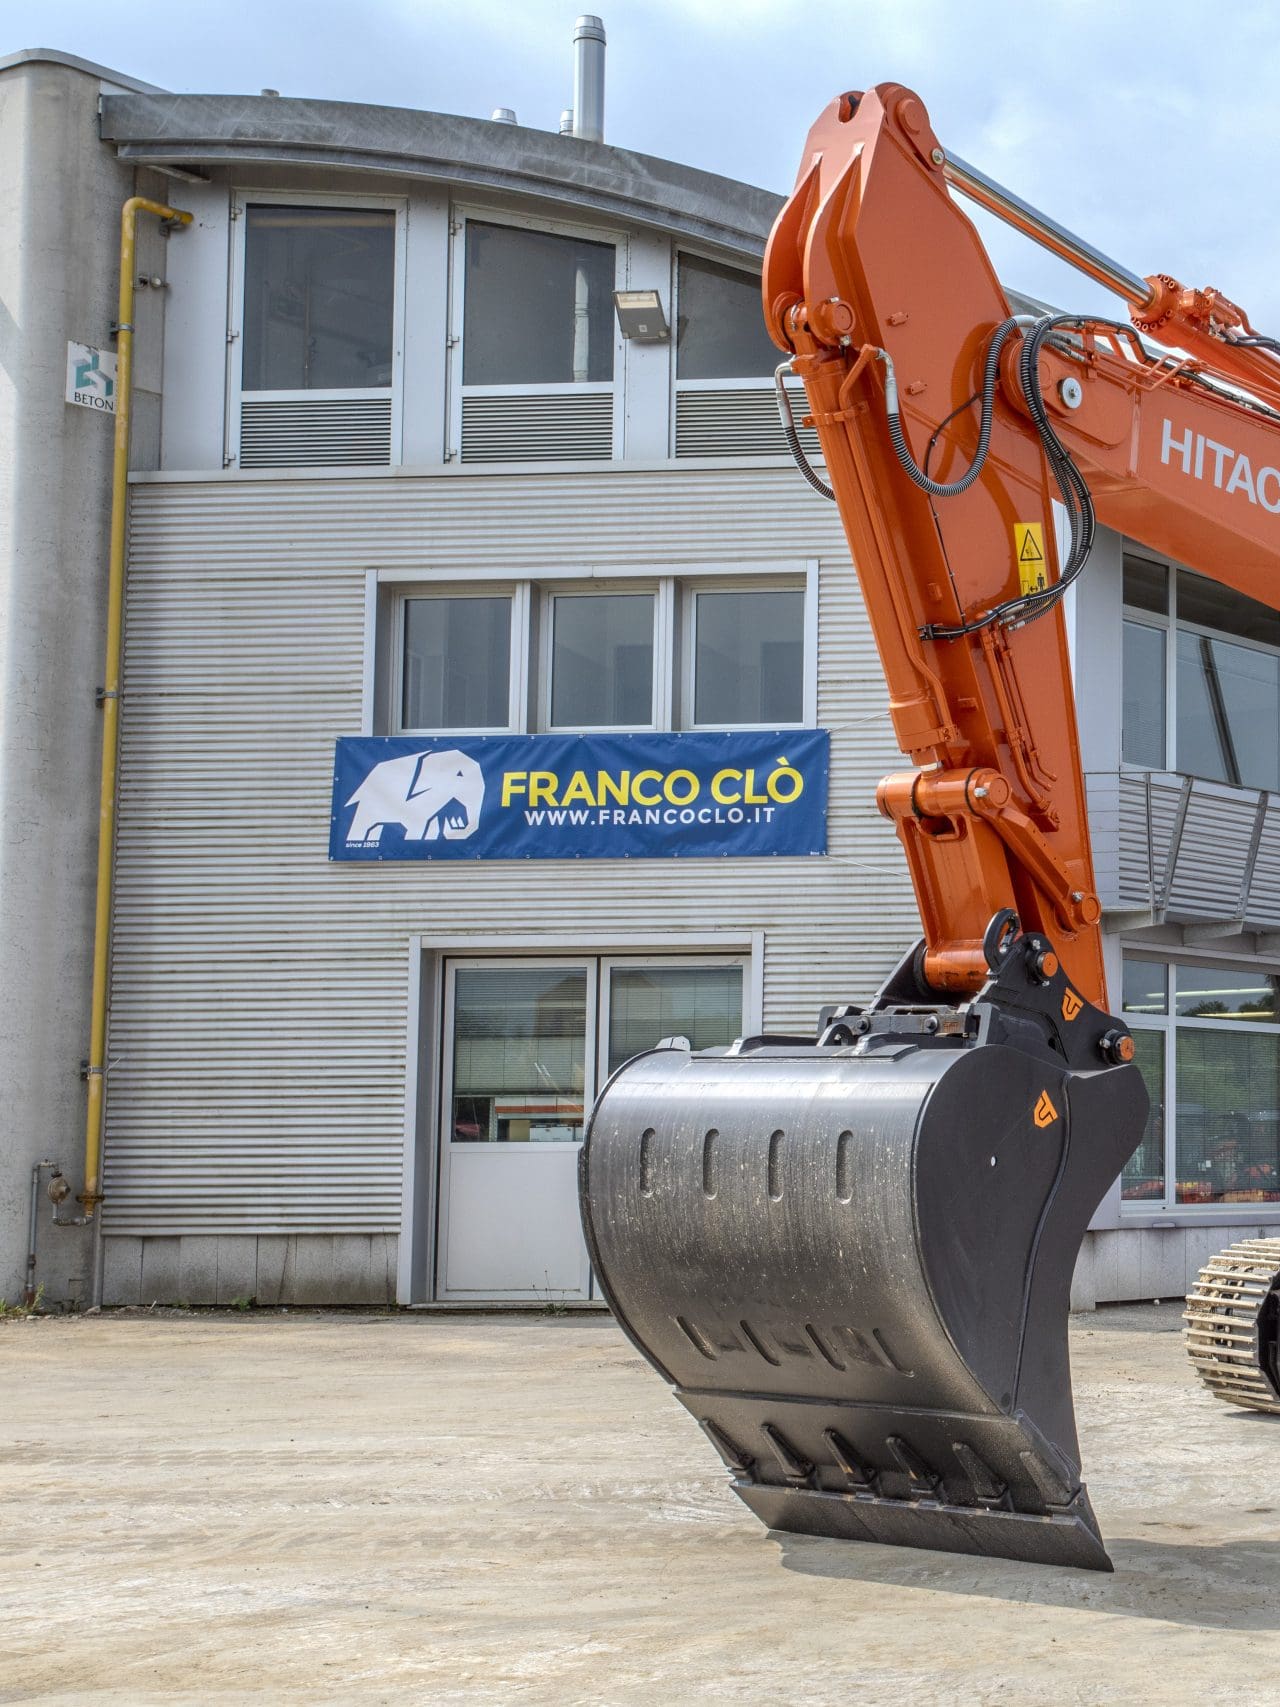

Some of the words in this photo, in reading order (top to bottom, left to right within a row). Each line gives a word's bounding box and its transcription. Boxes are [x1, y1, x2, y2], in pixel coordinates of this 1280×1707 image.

[74, 391, 114, 411] BETON
[501, 769, 700, 807] FRANCO
[711, 756, 804, 805] CLÒ
[524, 807, 775, 826] WWW.FRANCOCLO.IT
